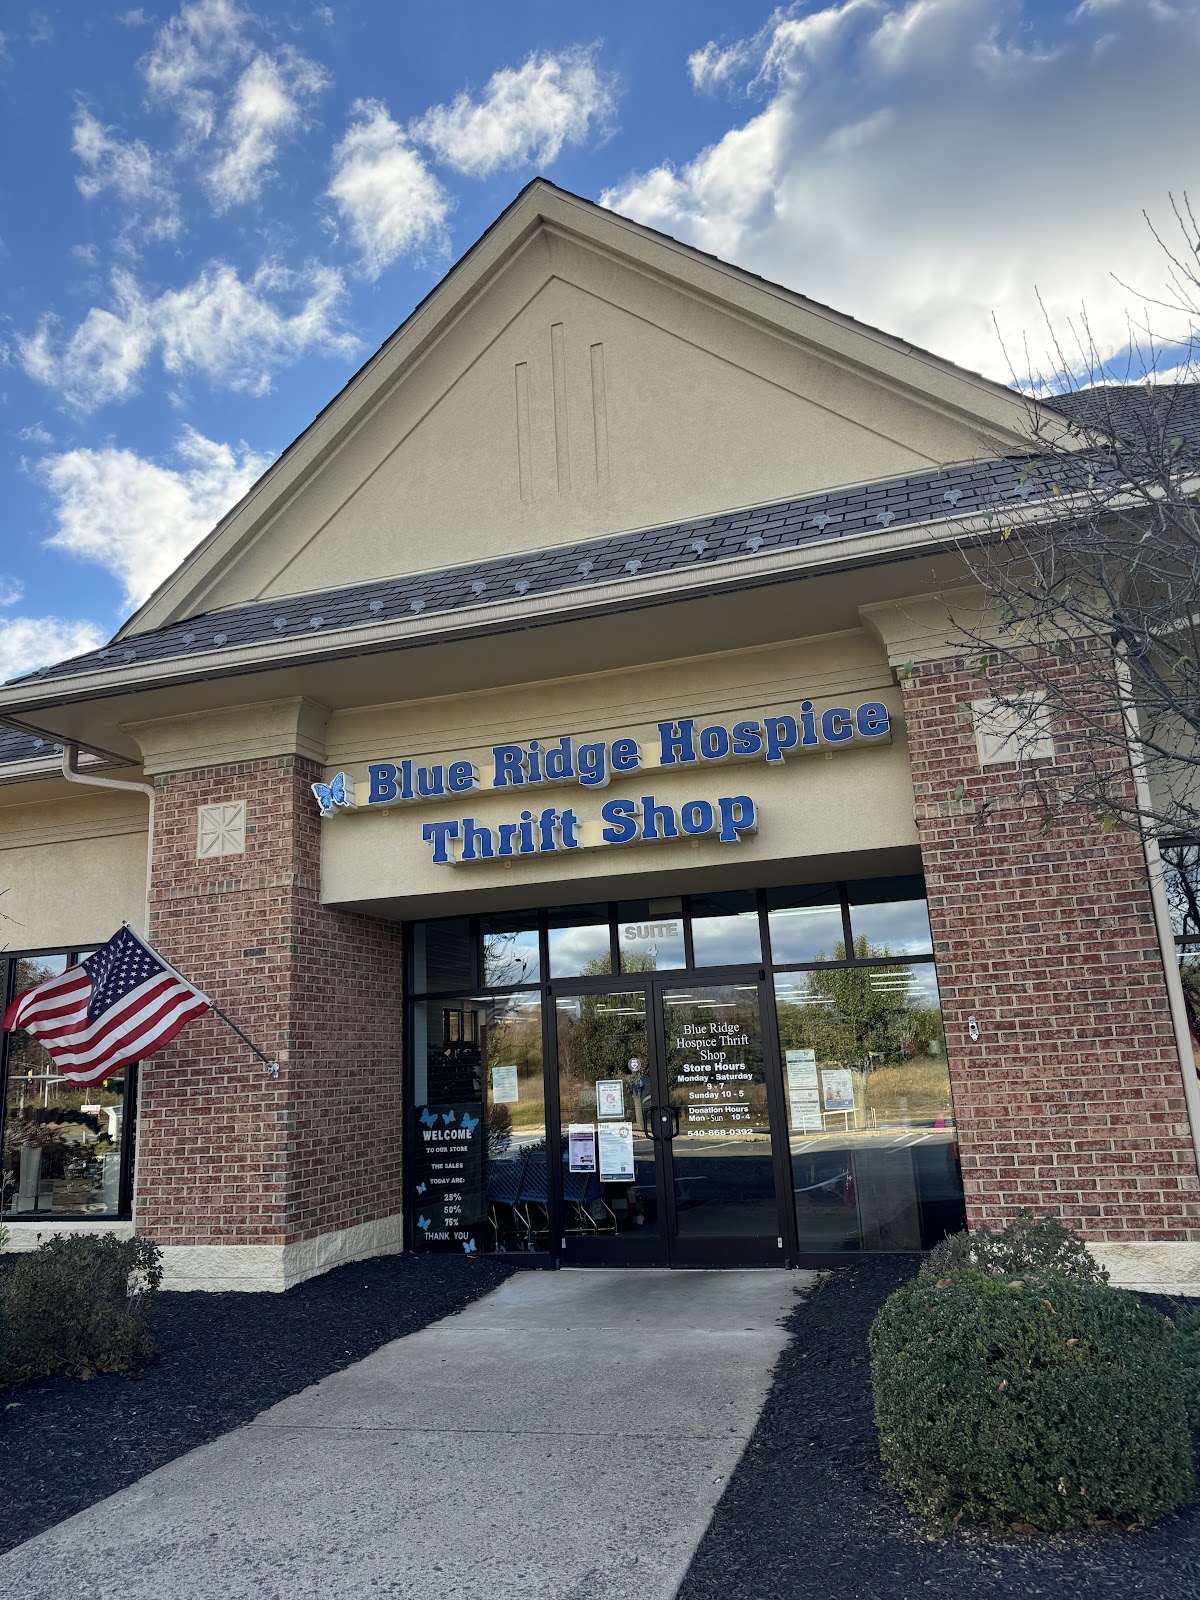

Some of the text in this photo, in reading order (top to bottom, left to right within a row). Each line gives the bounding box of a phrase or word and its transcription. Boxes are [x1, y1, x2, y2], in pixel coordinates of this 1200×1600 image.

[367, 699, 892, 805] Blue Ridge Hospice
[422, 795, 756, 865] Thrift Shop
[624, 922, 678, 940] SUITE
[645, 943, 658, 957] 4
[683, 1022, 740, 1035] Blue Ridge
[676, 1034, 749, 1050] Hospice Thrift
[700, 1049, 726, 1062] Shop
[683, 1062, 746, 1072] Store Hours
[677, 1074, 709, 1082] Monday
[715, 1073, 753, 1081] Saturday
[721, 1090, 731, 1098] 10
[423, 1129, 473, 1141] WELCOME
[687, 1128, 754, 1137] 540-868-0392
[443, 1193, 462, 1201] 25%
[443, 1205, 462, 1214] 50%
[444, 1218, 459, 1226] 75%
[424, 1231, 469, 1241] THANK YOU
